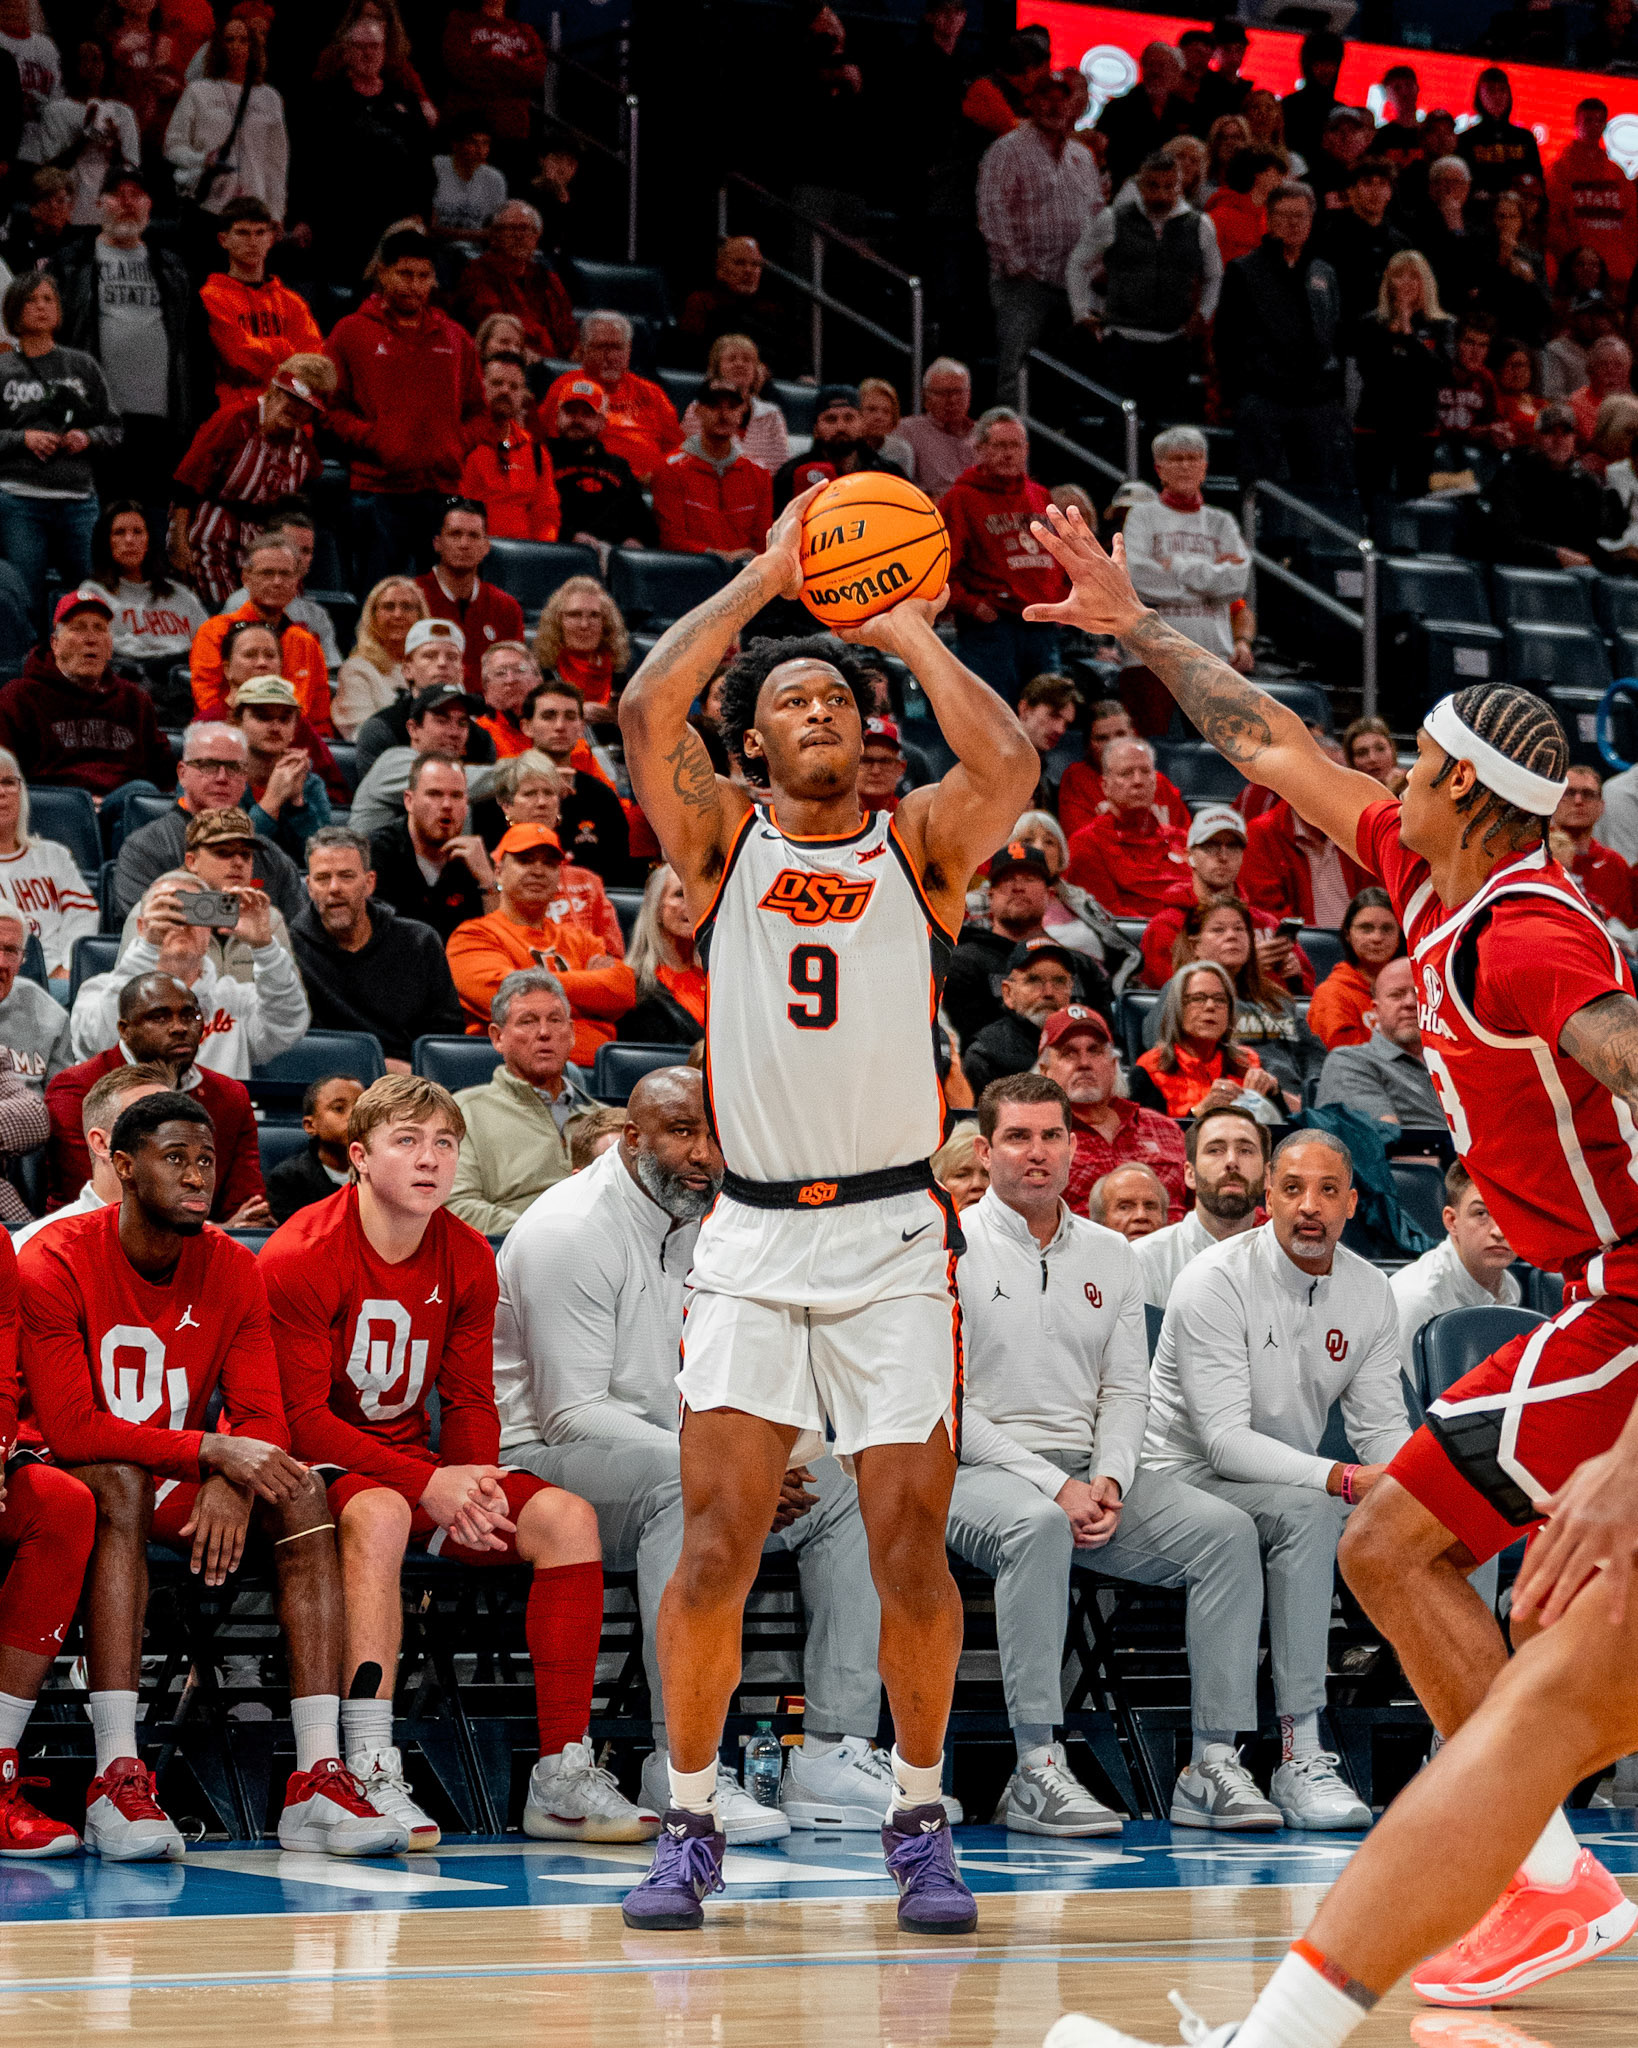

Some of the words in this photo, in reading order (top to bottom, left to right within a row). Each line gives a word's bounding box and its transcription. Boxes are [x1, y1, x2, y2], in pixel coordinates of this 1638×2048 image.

[810, 519, 867, 557] EVO
[808, 562, 913, 607] Wilson
[757, 868, 877, 925] OSU
[787, 943, 839, 1031] 9
[797, 1181, 839, 1206] OSU
[1083, 1281, 1104, 1309] OU
[346, 1299, 430, 1421] OU
[1324, 1328, 1350, 1363] OU
[100, 1324, 190, 1430] OU
